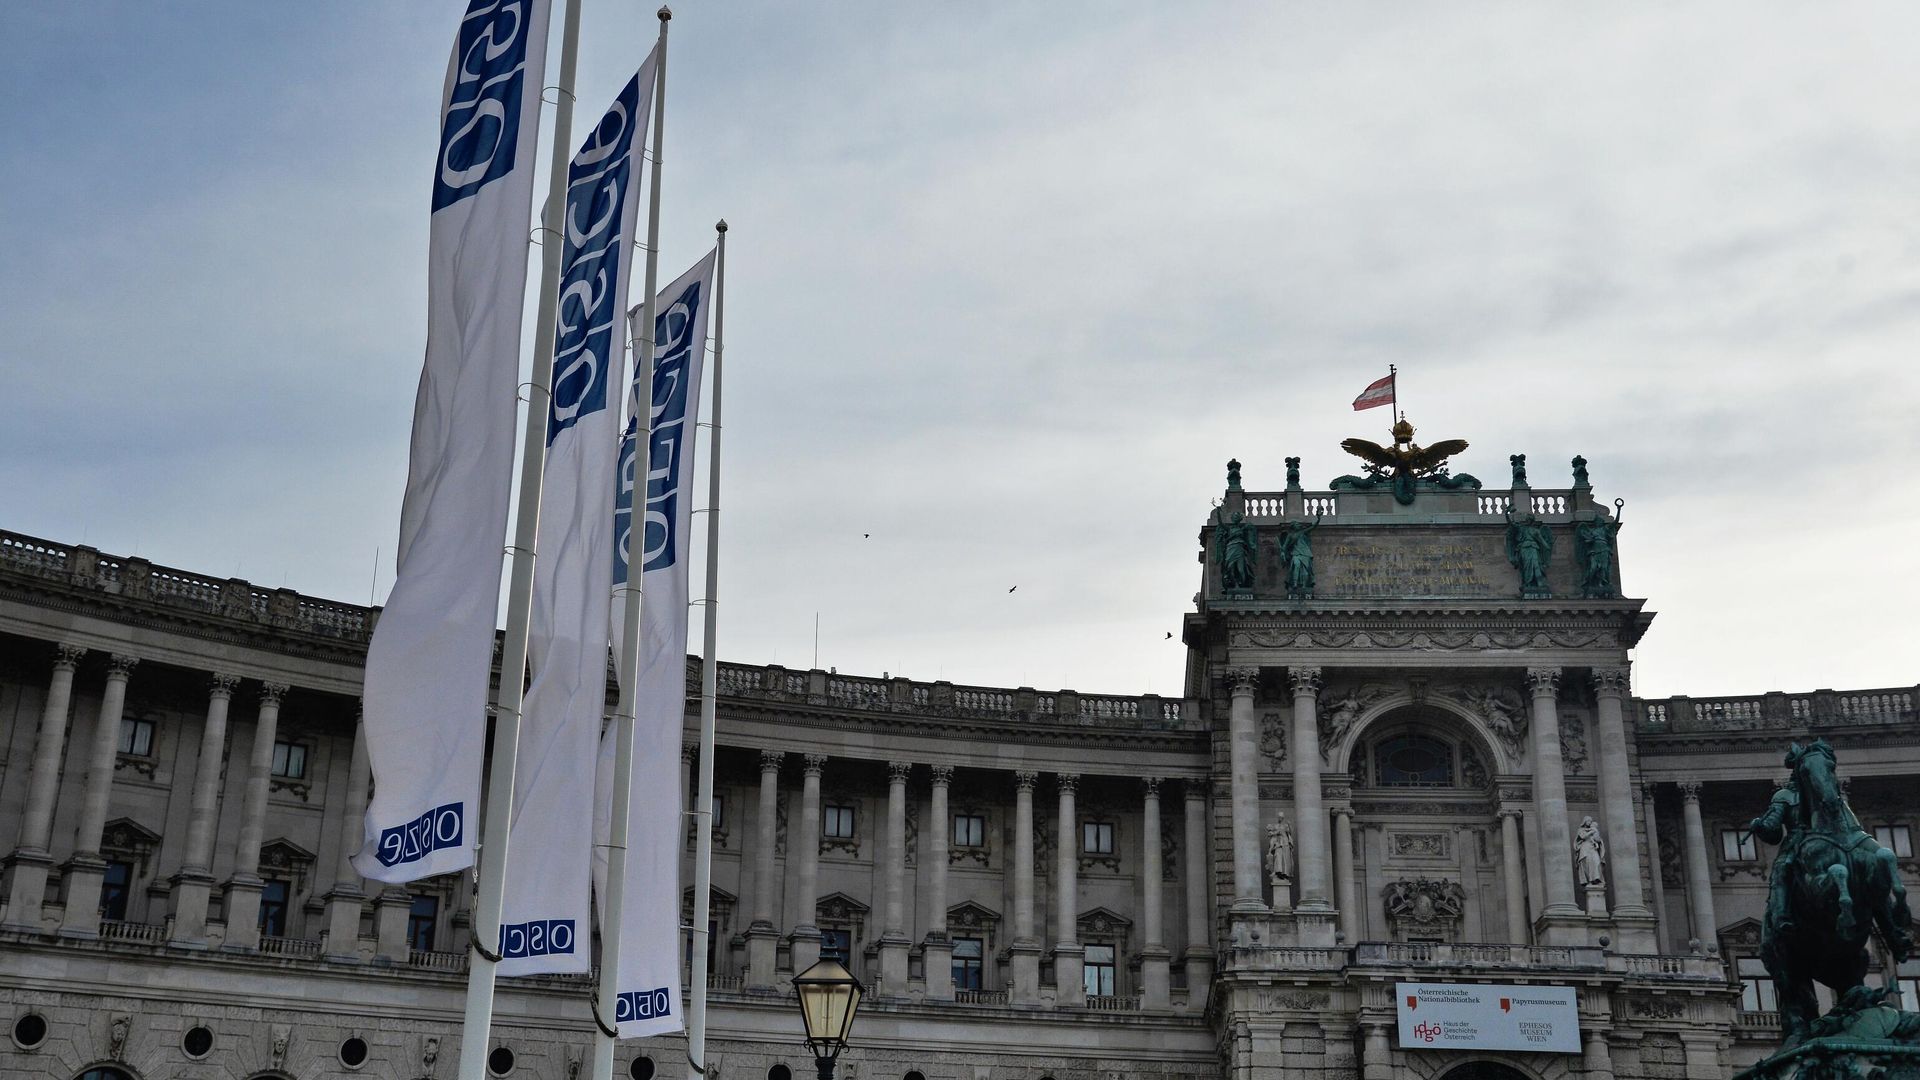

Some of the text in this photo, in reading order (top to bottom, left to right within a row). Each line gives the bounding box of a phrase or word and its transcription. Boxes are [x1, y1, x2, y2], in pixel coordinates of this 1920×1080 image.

[1418, 987, 1468, 996] Österreichische
[1418, 996, 1481, 1004] Nationalbibliothek
[1512, 998, 1567, 1006] Papyrusmuseum
[1443, 1033, 1476, 1041] Österreich
